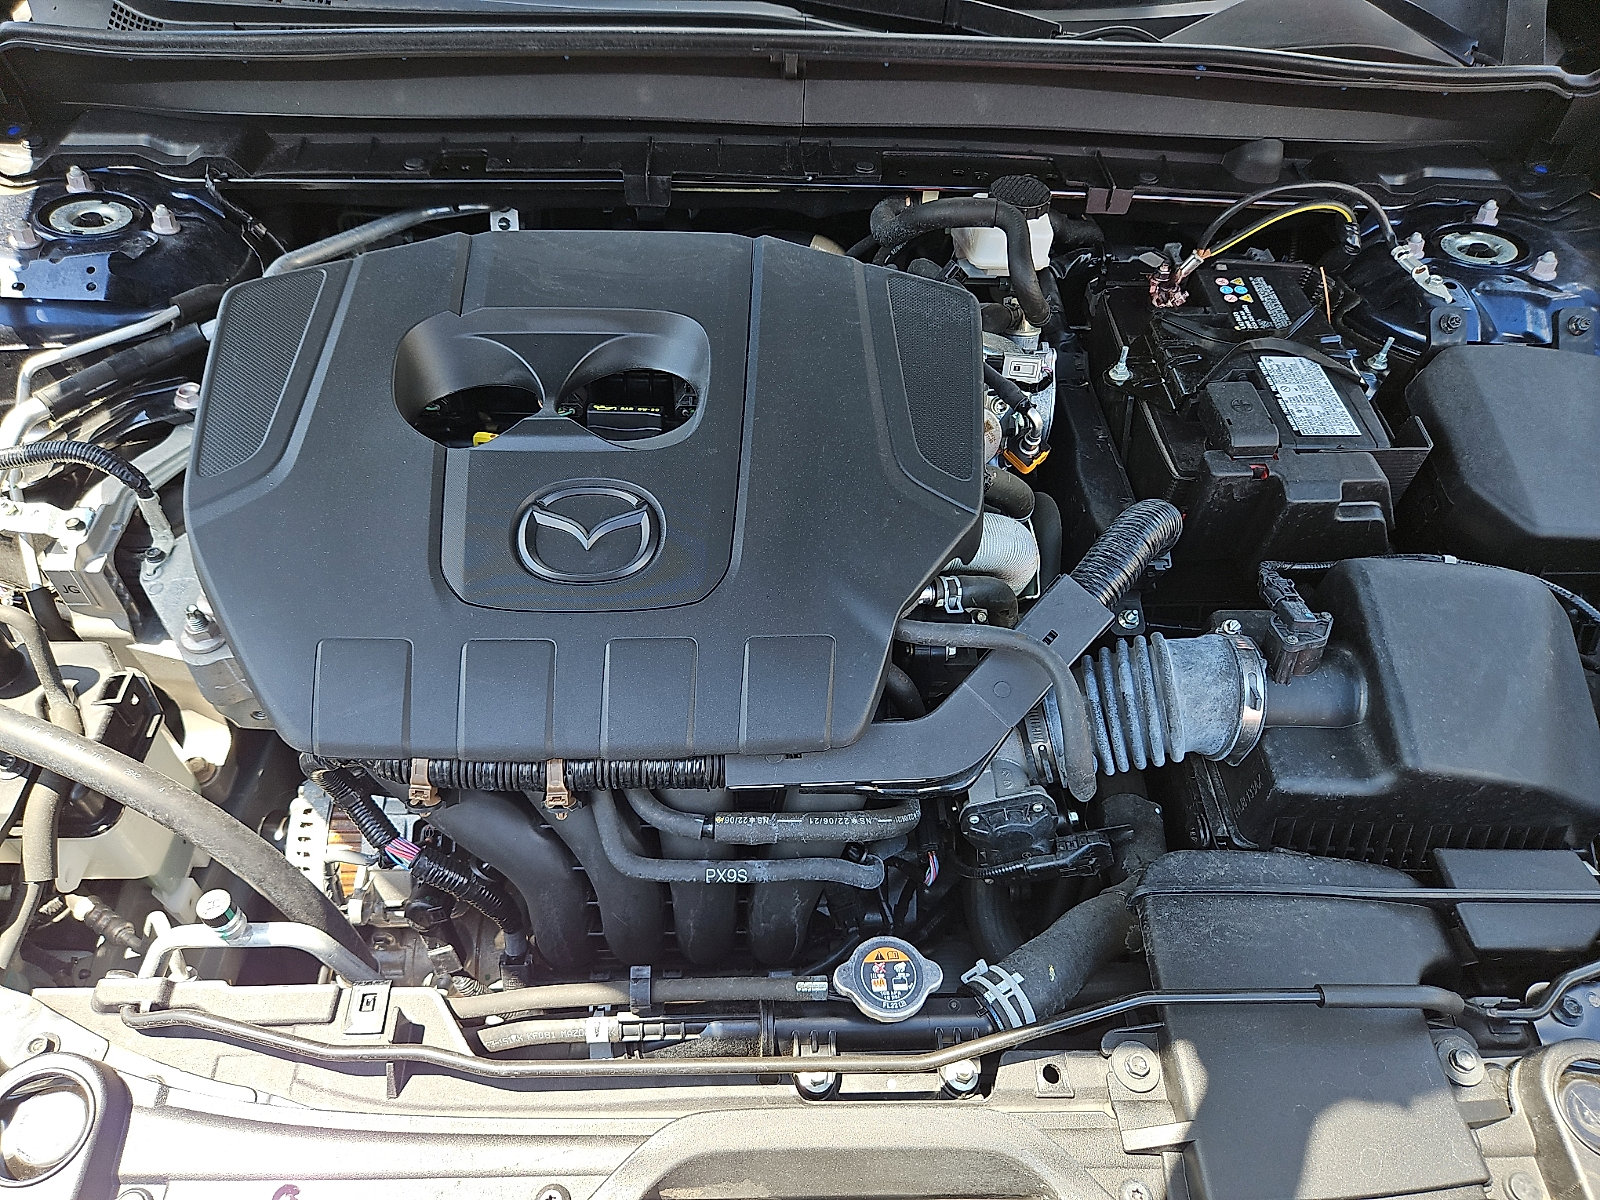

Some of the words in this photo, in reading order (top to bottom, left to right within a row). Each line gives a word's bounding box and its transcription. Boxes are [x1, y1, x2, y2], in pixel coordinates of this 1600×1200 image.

[62, 584, 81, 594] JG
[705, 868, 748, 884] PX9S
[560, 1028, 587, 1038] MAZD
